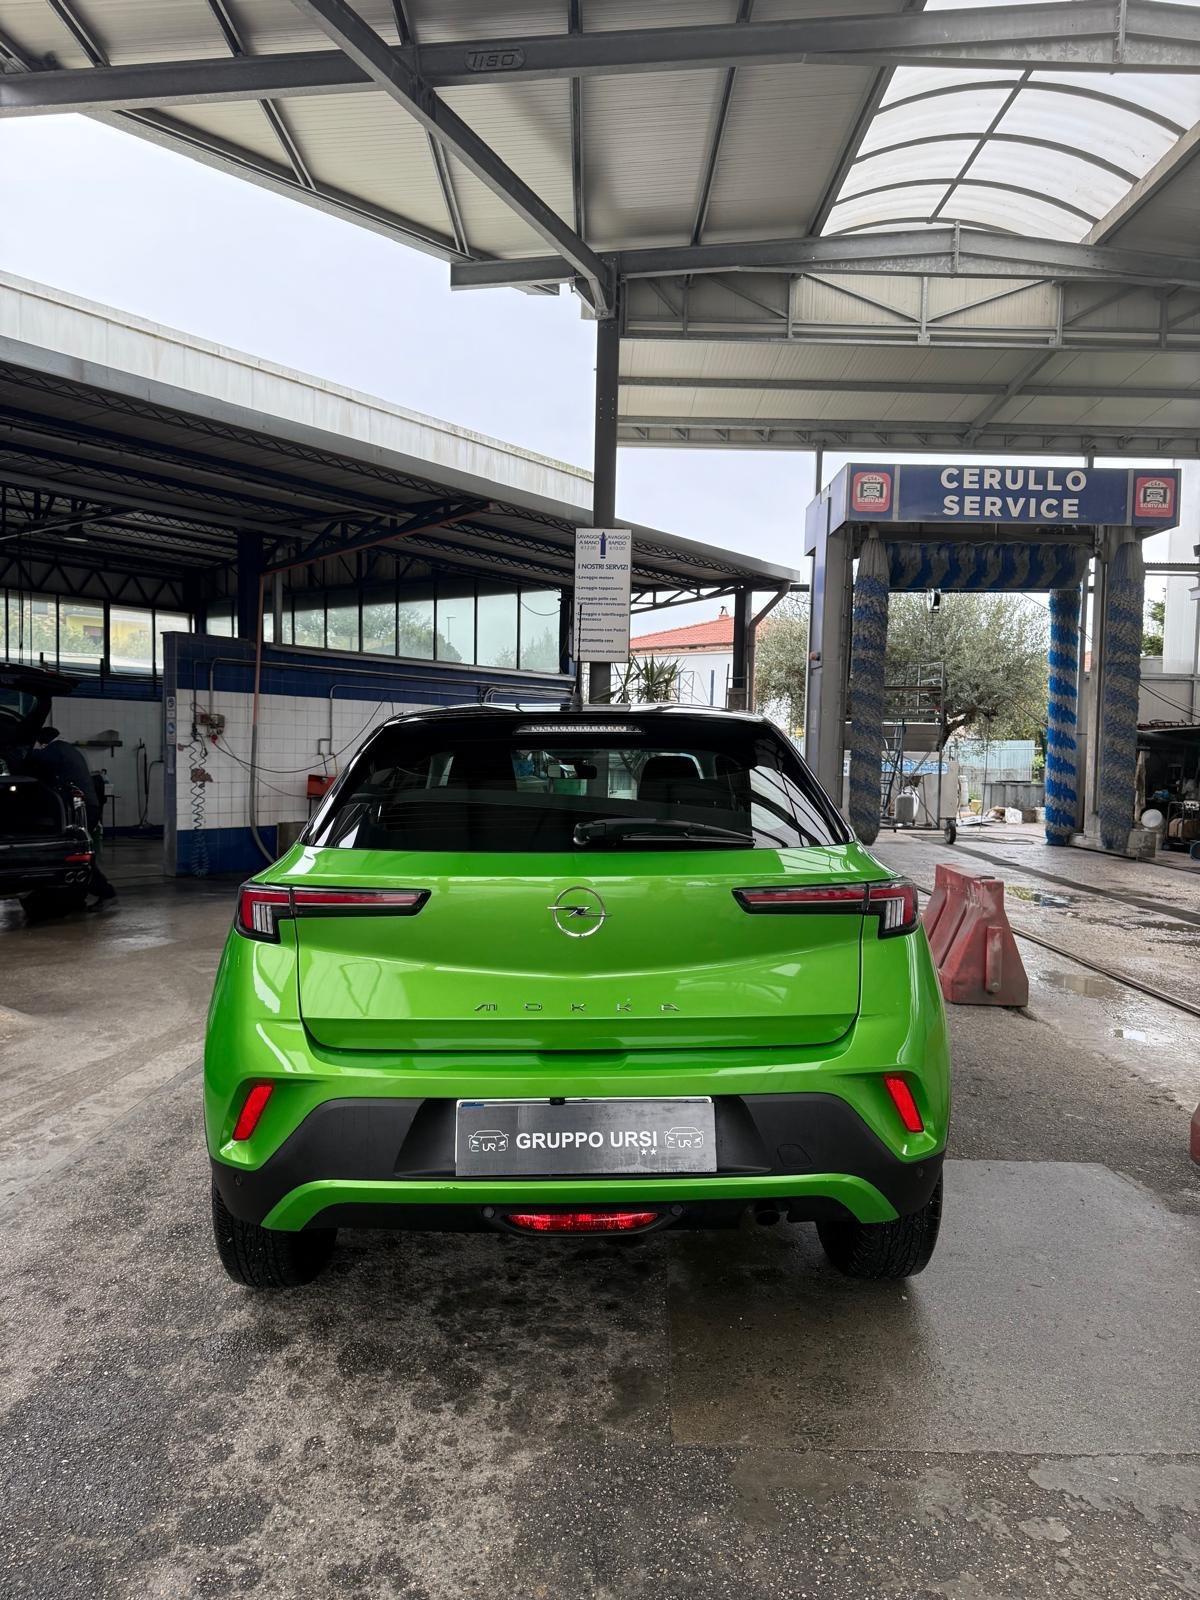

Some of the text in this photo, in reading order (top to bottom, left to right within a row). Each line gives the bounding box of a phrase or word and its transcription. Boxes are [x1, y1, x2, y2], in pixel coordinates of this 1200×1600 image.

[940, 467, 1087, 492] CERULLO
[943, 495, 1079, 519] SERVICE
[474, 1003, 680, 1011] MOKKA
[516, 1131, 604, 1149] GRUPPO
[610, 1131, 658, 1148] URSI
